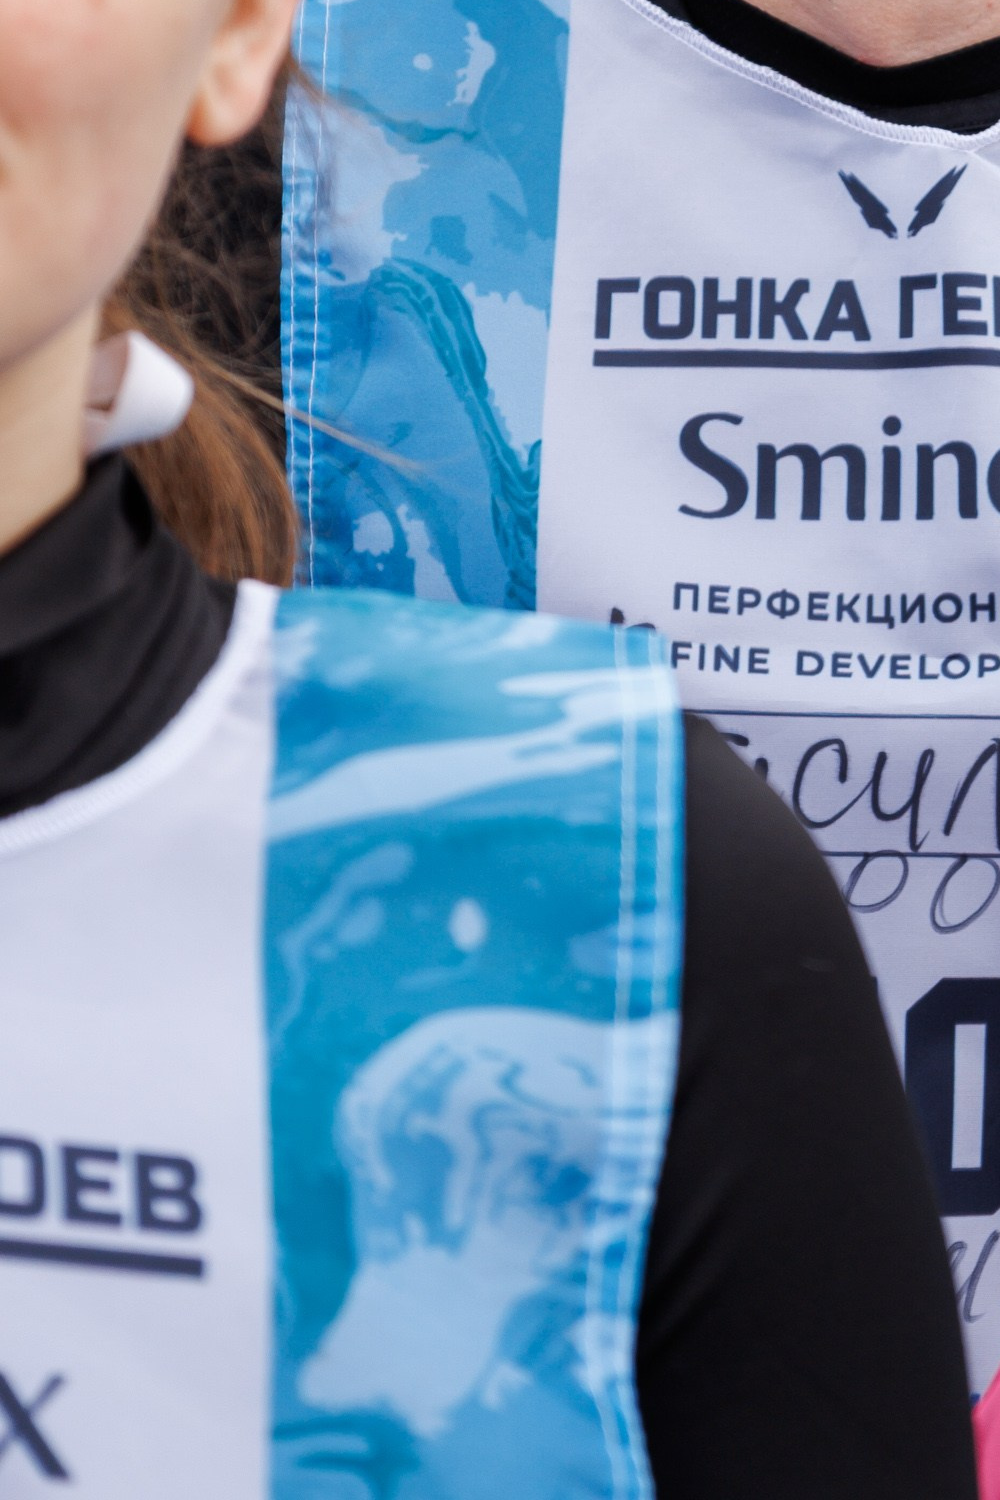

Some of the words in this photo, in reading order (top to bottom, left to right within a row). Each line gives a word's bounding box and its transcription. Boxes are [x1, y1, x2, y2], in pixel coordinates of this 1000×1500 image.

[594, 276, 872, 342] ГОНКА
[671, 641, 770, 674] FINE
[0, 1134, 204, 1234] ОЕВ
